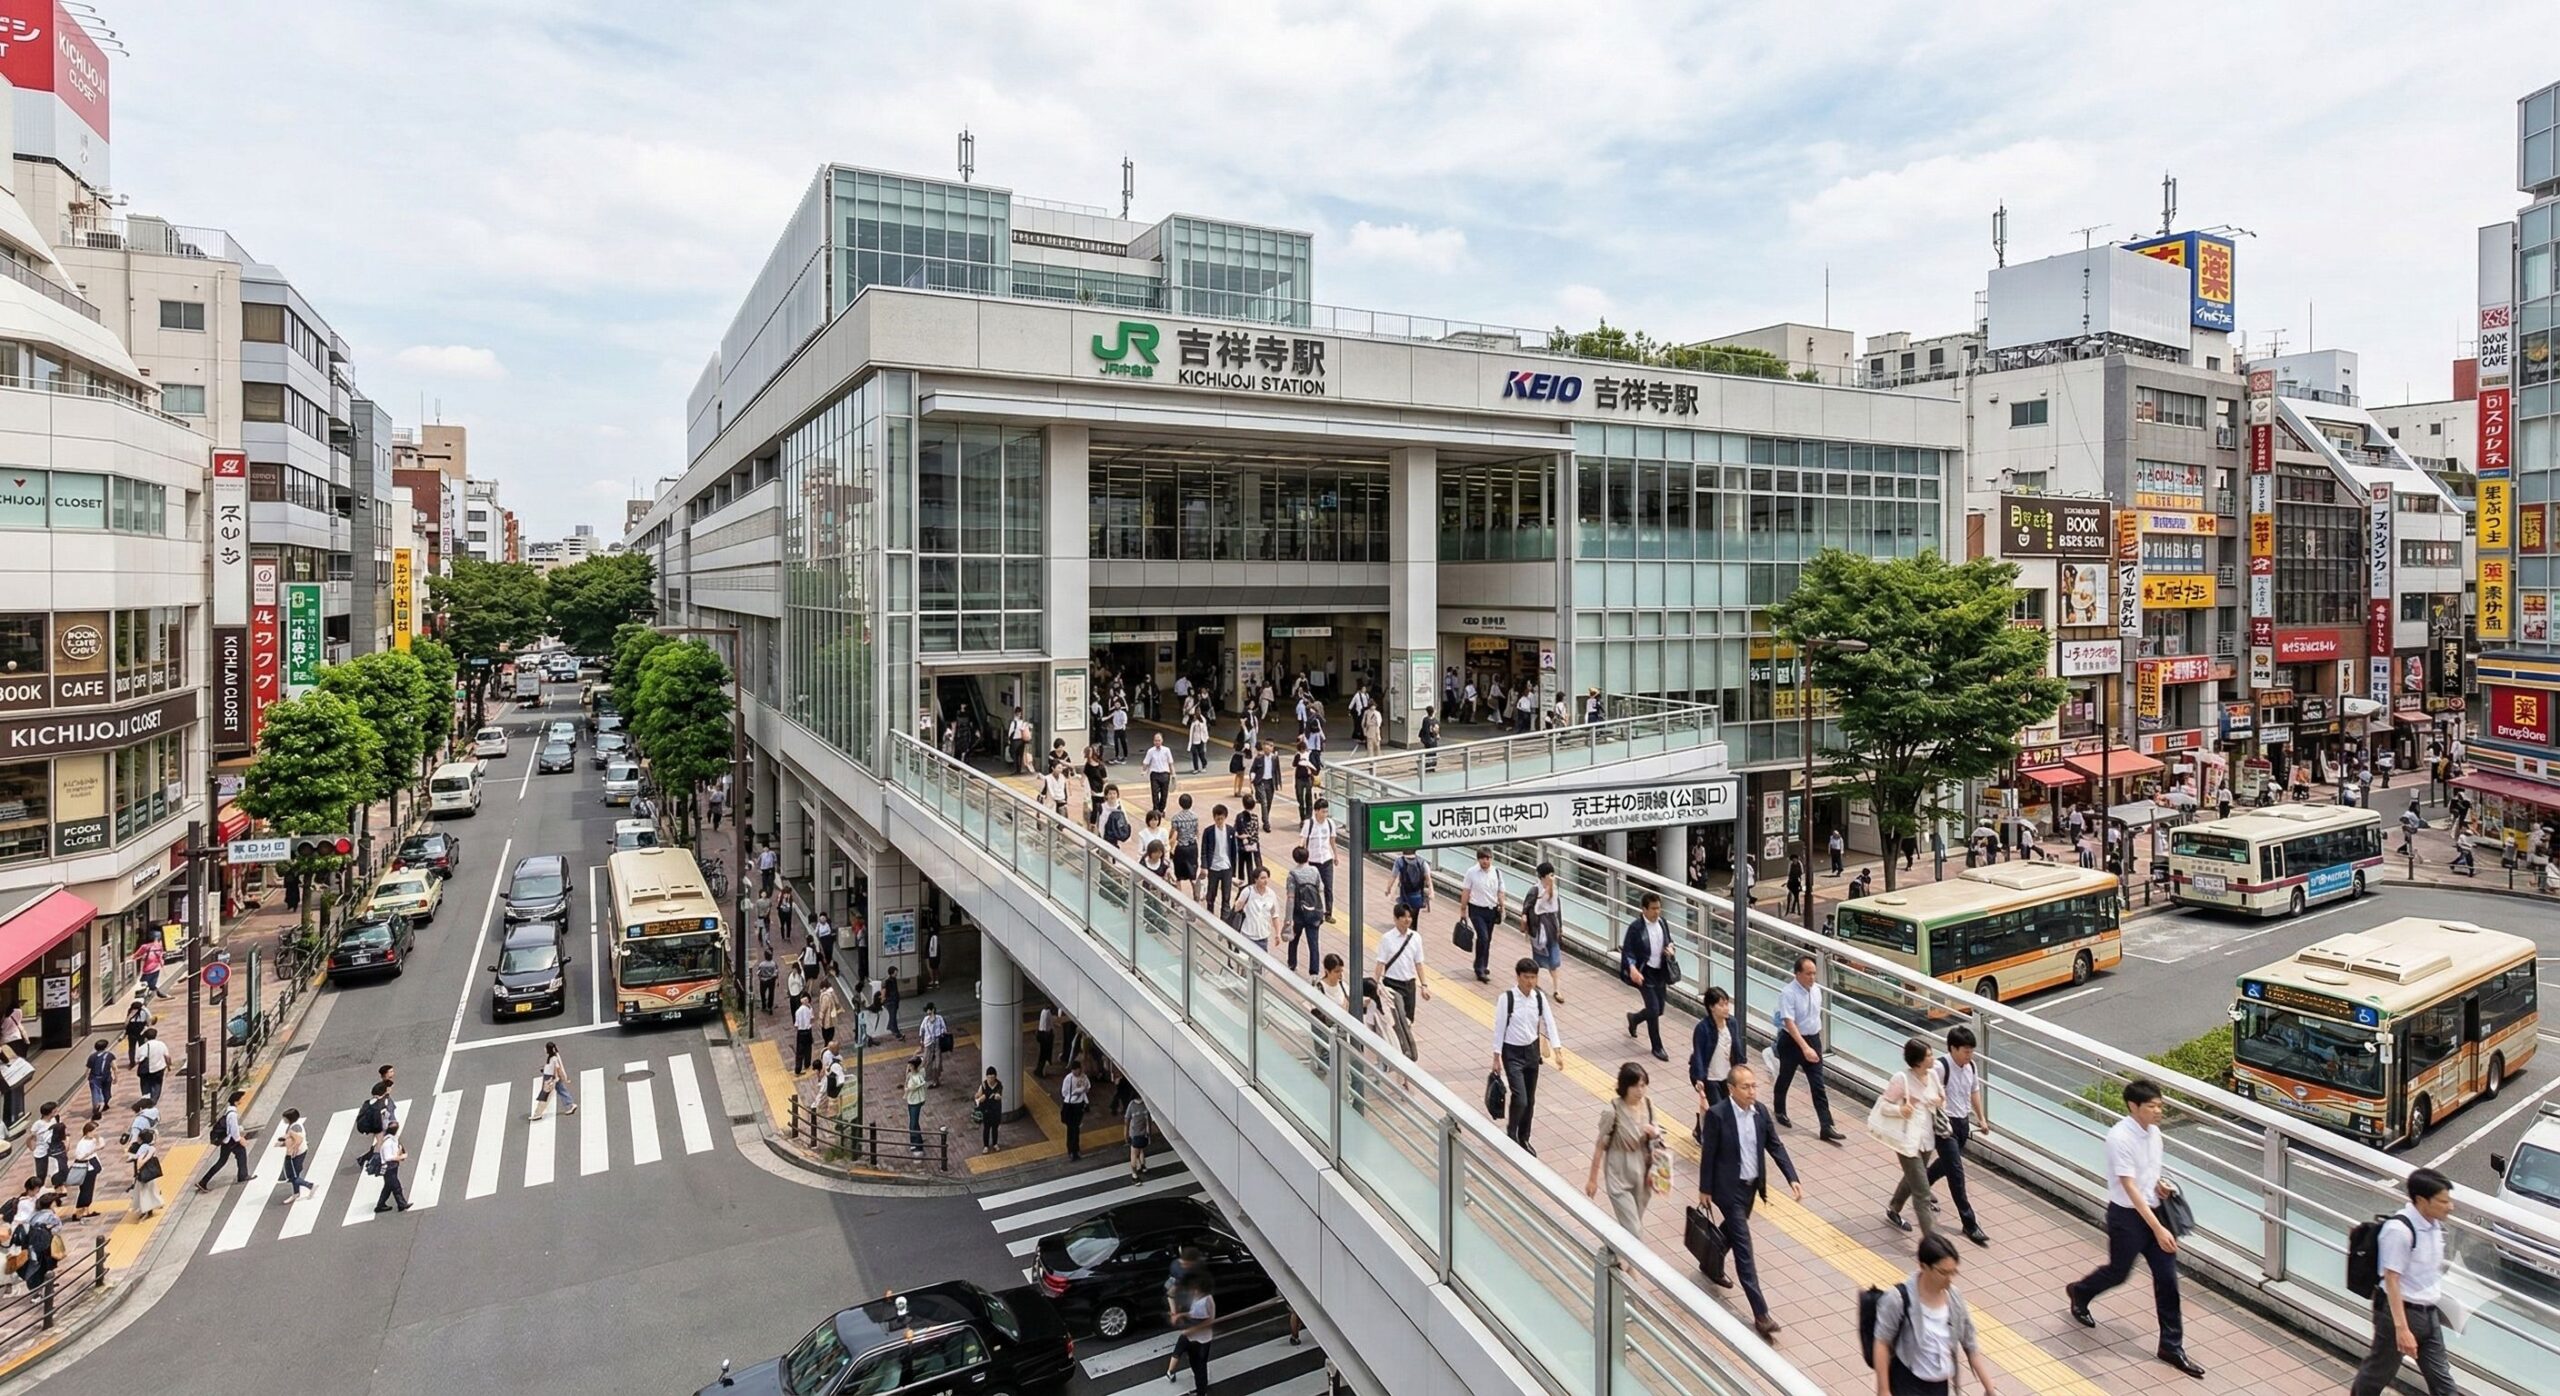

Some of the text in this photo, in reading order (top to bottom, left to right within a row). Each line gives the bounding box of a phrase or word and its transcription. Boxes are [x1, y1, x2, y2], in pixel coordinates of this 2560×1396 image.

[1092, 321, 1160, 364] JR
[1177, 328, 1326, 377] 吉祥寺駅
[1179, 369, 1325, 395] KICHIJOJI STATION
[1503, 371, 1583, 402] KEIO
[1593, 376, 1700, 415] 吉祥寺駅
[0, 494, 103, 509] HIJOJI CLOSET
[2066, 516, 2099, 533] BOOK
[61, 681, 104, 698] CAFE
[223, 687, 239, 732] CLOSET
[11, 709, 163, 748] KICHIJOJI CLOSET
[1379, 810, 1415, 834] JR
[1480, 824, 1518, 836] STATION
